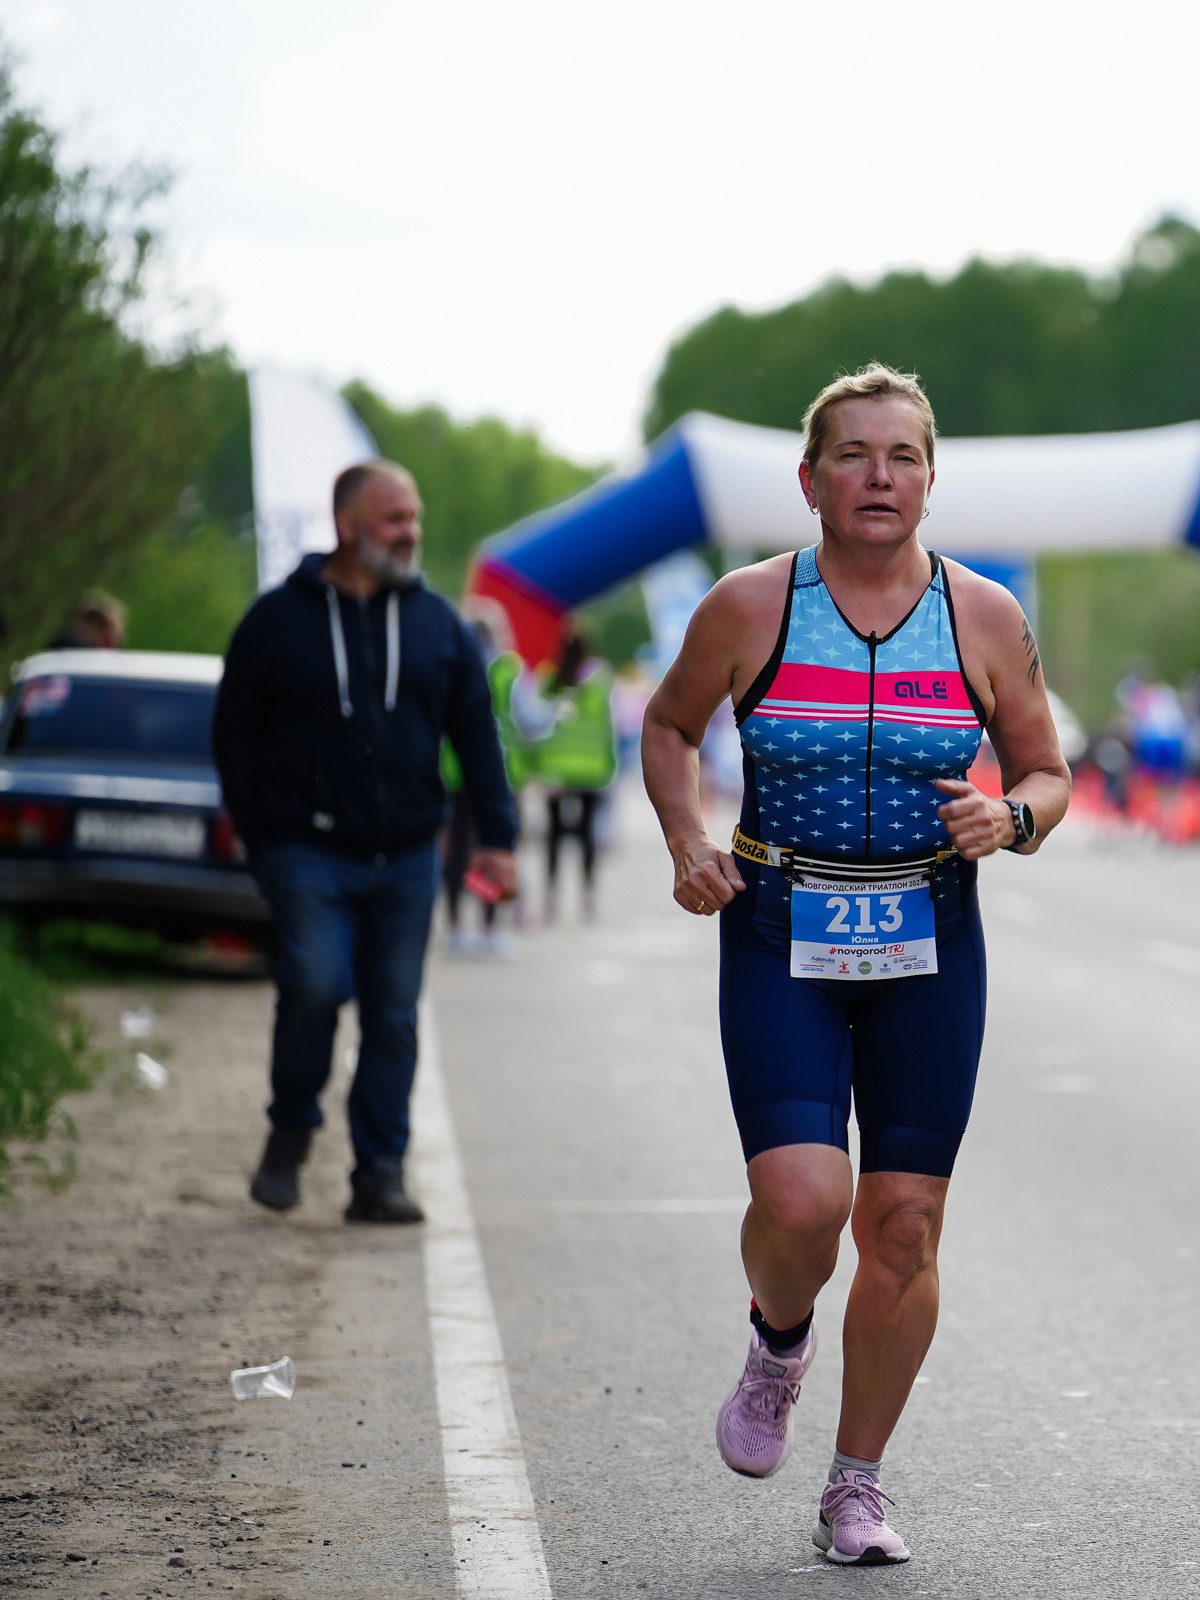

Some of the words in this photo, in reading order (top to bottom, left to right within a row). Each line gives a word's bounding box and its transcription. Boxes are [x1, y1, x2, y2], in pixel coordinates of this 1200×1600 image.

[802, 881, 867, 893] НОВГОРОДСКИЙ
[868, 881, 908, 891] ТРИАТЛОН
[908, 879, 924, 888] 2023
[825, 894, 904, 933] 213
[851, 935, 879, 944] Юлия
